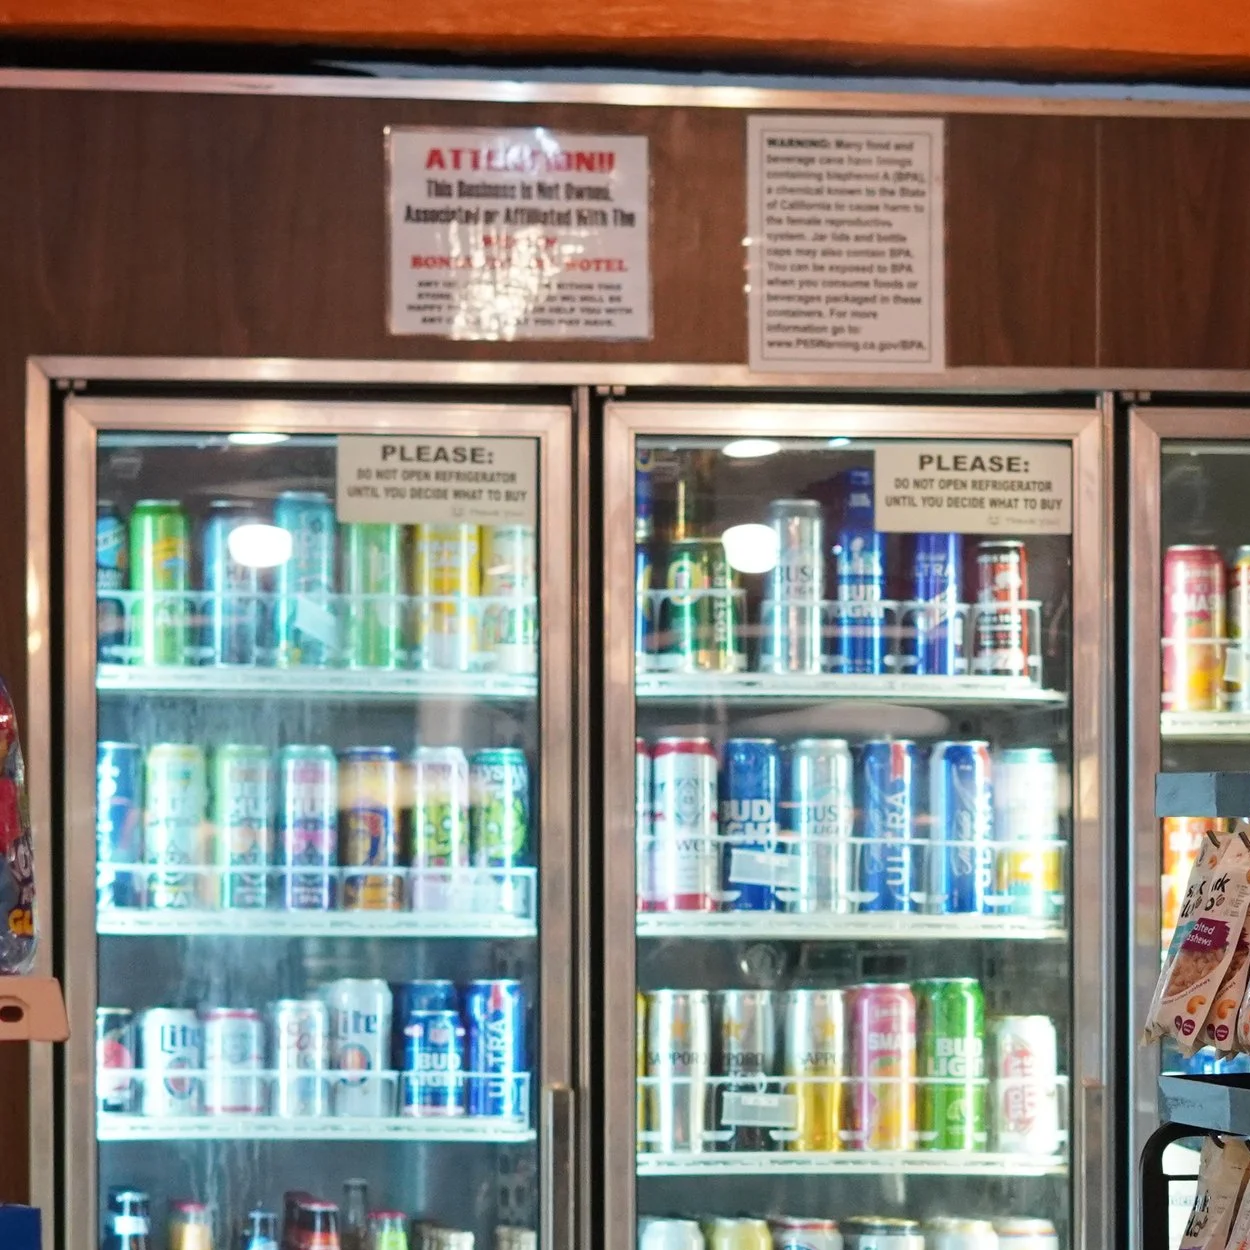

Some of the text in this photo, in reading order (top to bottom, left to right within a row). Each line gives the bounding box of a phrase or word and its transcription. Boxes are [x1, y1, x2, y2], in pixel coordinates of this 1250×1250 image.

[767, 138, 830, 149] WARNING:
[426, 180, 452, 198] This
[484, 211, 499, 225] or
[613, 209, 636, 227] The
[381, 444, 495, 465] PLEASE:
[918, 454, 1030, 473] PLEASE:
[356, 468, 517, 483] DO NOT OPEN REFRIGERATOR
[347, 486, 528, 502] UNTIL YOU DECIDE WHAT TO BUY
[894, 478, 1053, 493] DO NOT OPEN REFRIGERATOR
[885, 496, 1063, 510] UNTIL YOU DECIDE WHAT TO BUY
[886, 786, 908, 886] ULTRA
[936, 1037, 984, 1056] BUD
[419, 1053, 462, 1071] BUD
